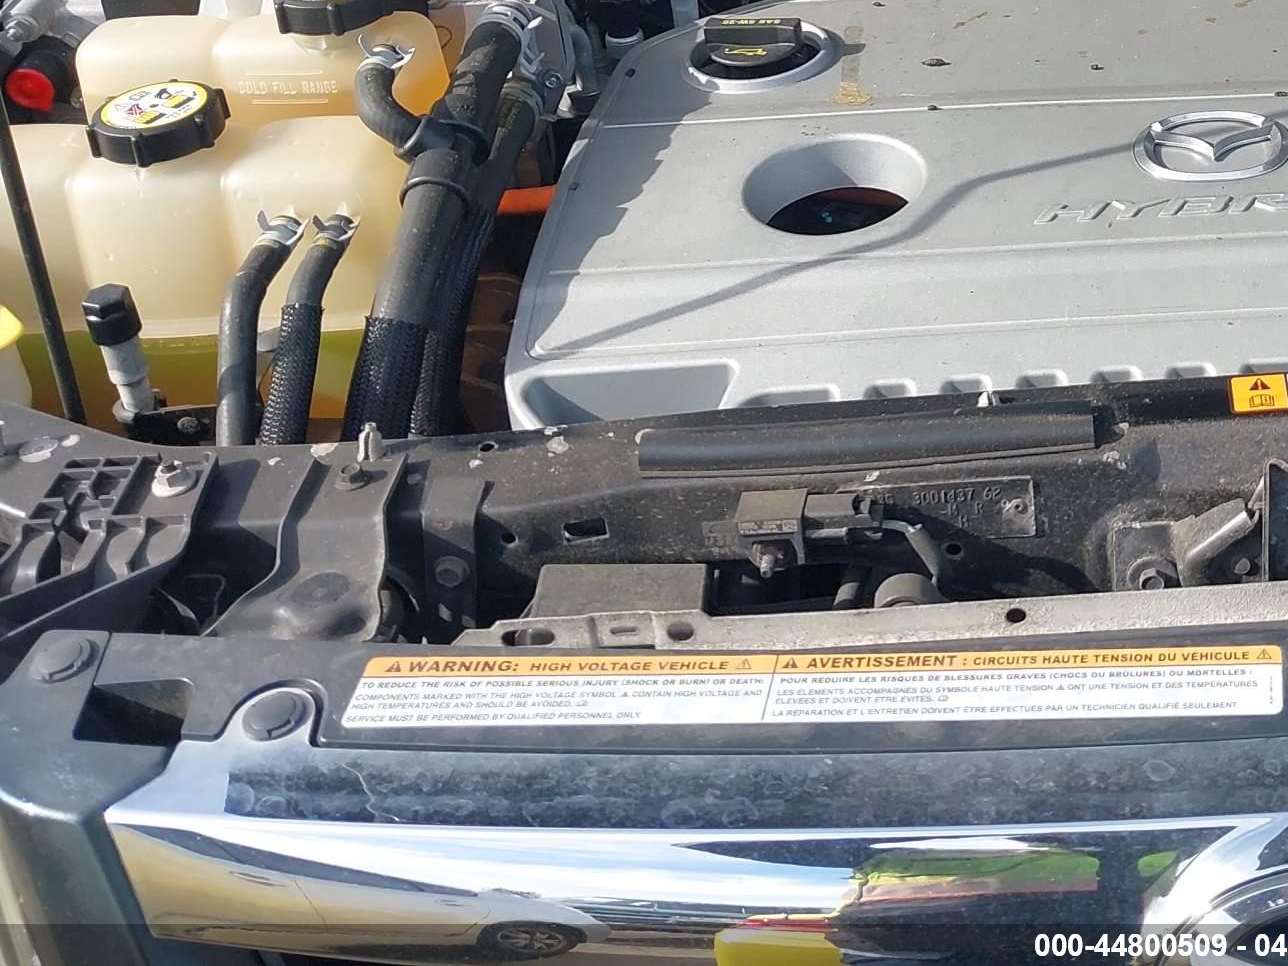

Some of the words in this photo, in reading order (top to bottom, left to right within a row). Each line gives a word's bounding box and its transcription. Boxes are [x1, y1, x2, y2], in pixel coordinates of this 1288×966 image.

[238, 81, 267, 94] COLD
[272, 81, 297, 94] FILL
[302, 81, 339, 94] RANGE
[806, 656, 958, 668] AVERTISSEMENT
[973, 656, 1037, 666] CIRCUITS
[1042, 654, 1088, 664] HAUTE
[1093, 653, 1154, 663] TENSION
[1158, 652, 1176, 662] DU
[1181, 650, 1250, 661] VÉHICULE
[408, 661, 519, 672] WARNING:
[529, 662, 572, 672] HIGH
[578, 662, 652, 672] VOLTAGE
[658, 661, 730, 670] VEHICLE
[880, 674, 924, 682] RISQUES
[943, 673, 1002, 681] BLESSURES
[1006, 672, 1046, 680] GRAVES
[360, 681, 375, 689] TO
[376, 681, 417, 689] REDUCE
[484, 680, 533, 688] POSSIBLE
[354, 693, 420, 701] COMPONENTS
[421, 693, 463, 701] MARKED
[508, 692, 532, 700] HIGH
[578, 691, 616, 699] SYMBOL
[672, 690, 696, 698] HIGH
[742, 689, 762, 697] AND
[351, 702, 374, 710] HIGH
[377, 701, 450, 709] TEMPERATURES
[344, 714, 386, 723] SERVICE
[386, 714, 413, 722] MUST
[415, 714, 429, 722] BE
[430, 713, 490, 722] PERFORMED
[490, 713, 504, 721] BY
[505, 713, 556, 721] QUALIFIED
[556, 712, 614, 720] PERSONNEL
